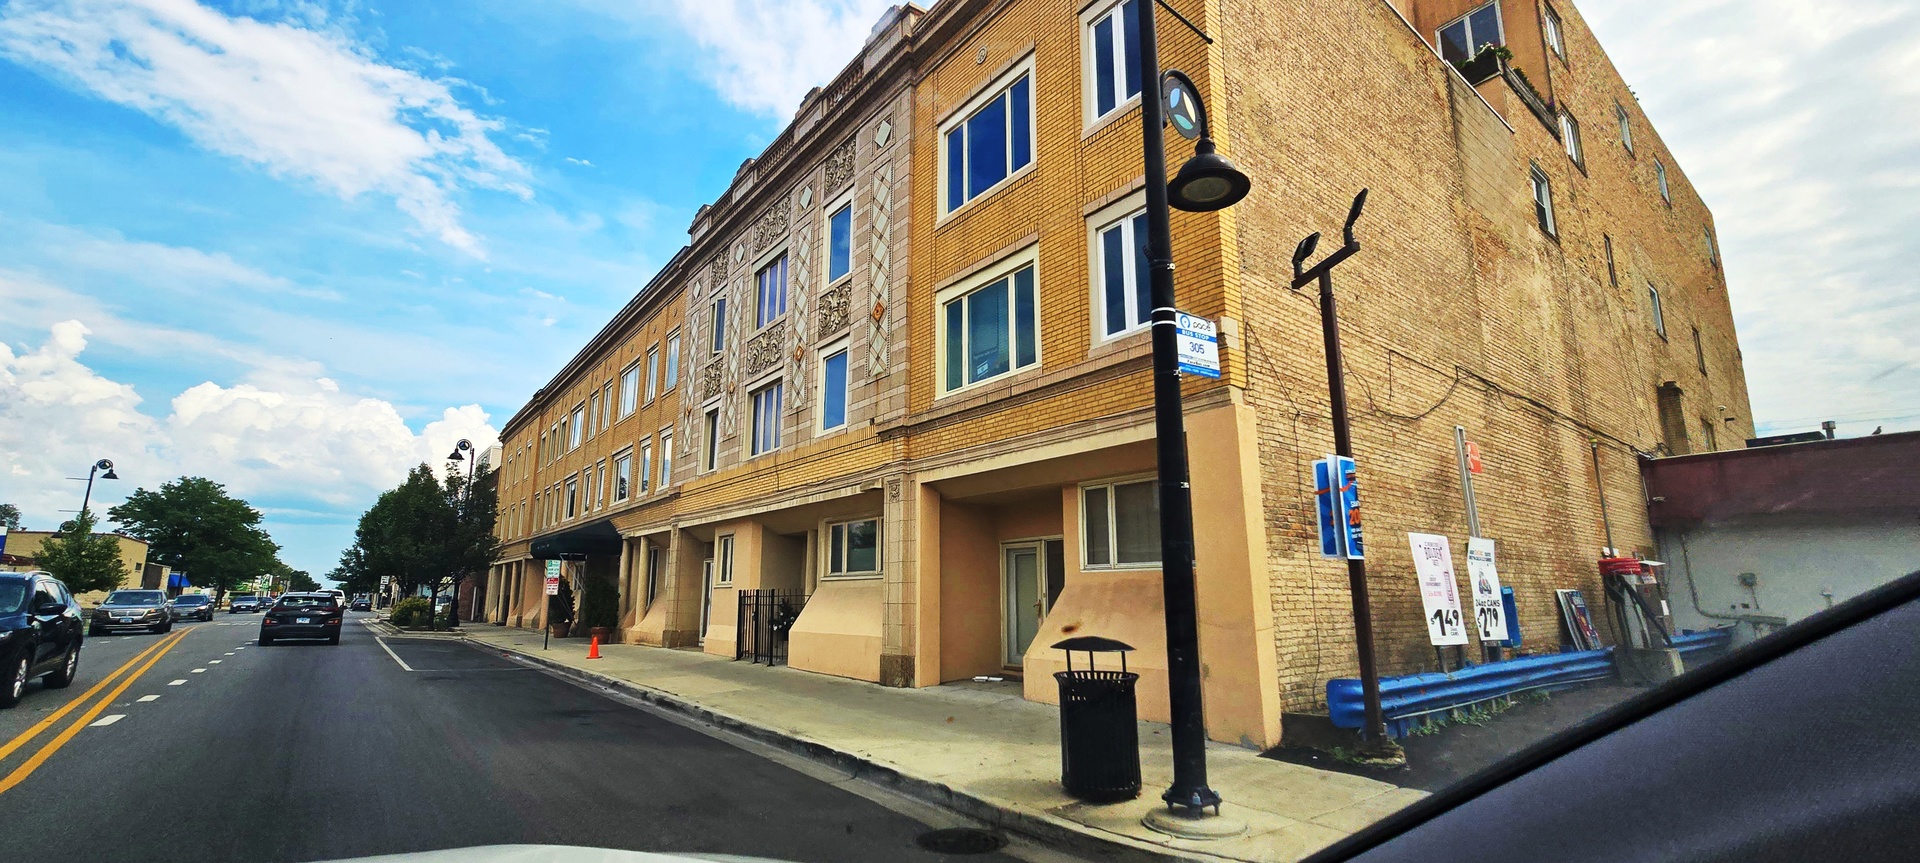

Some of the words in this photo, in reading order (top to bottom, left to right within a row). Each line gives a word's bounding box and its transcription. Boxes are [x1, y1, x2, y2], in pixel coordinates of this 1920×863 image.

[1193, 322, 1211, 331] pace
[1181, 329, 1194, 337] BUS
[1194, 332, 1210, 340] STOP
[1189, 341, 1205, 354] 305
[1487, 599, 1501, 607] CANS
